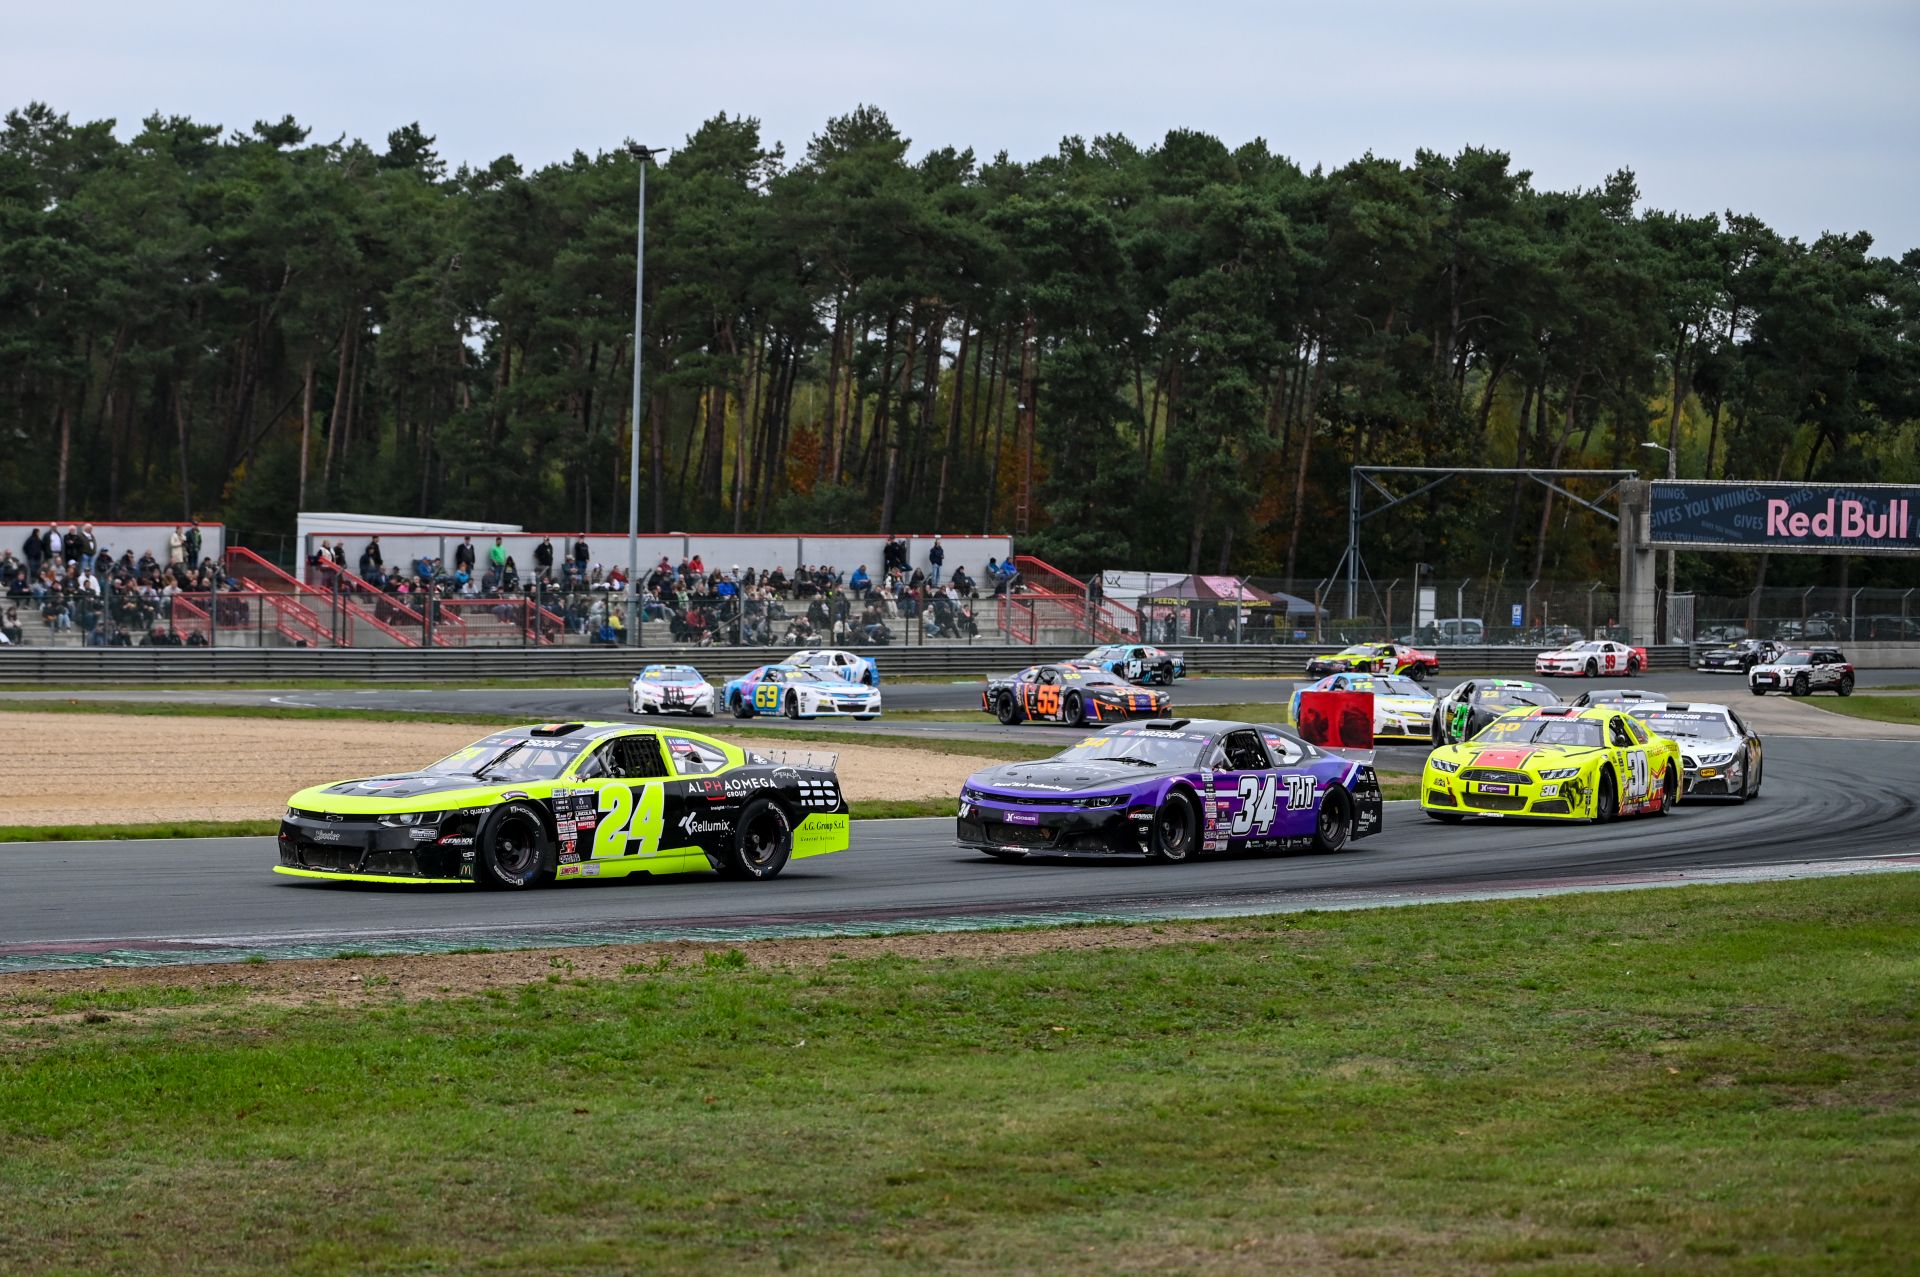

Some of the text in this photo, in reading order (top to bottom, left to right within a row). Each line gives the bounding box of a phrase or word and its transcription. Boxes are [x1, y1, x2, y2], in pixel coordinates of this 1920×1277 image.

[1684, 499, 1710, 518] YOU
[1734, 514, 1763, 530] GIVES
[1767, 498, 1835, 537] Red
[1841, 500, 1908, 538] Bull
[1381, 658, 1398, 674] 3
[1605, 654, 1616, 669] 99
[755, 685, 778, 708] 69
[1037, 684, 1060, 715] 55
[1134, 730, 1186, 739] NASCAR
[1627, 750, 1648, 798] 30
[688, 778, 778, 794] ALPHAOMEGA
[1541, 785, 1558, 796] 30
[959, 803, 972, 818] 34
[1231, 774, 1278, 837] 34
[591, 782, 665, 860] 24
[691, 819, 730, 833] Rellumix
